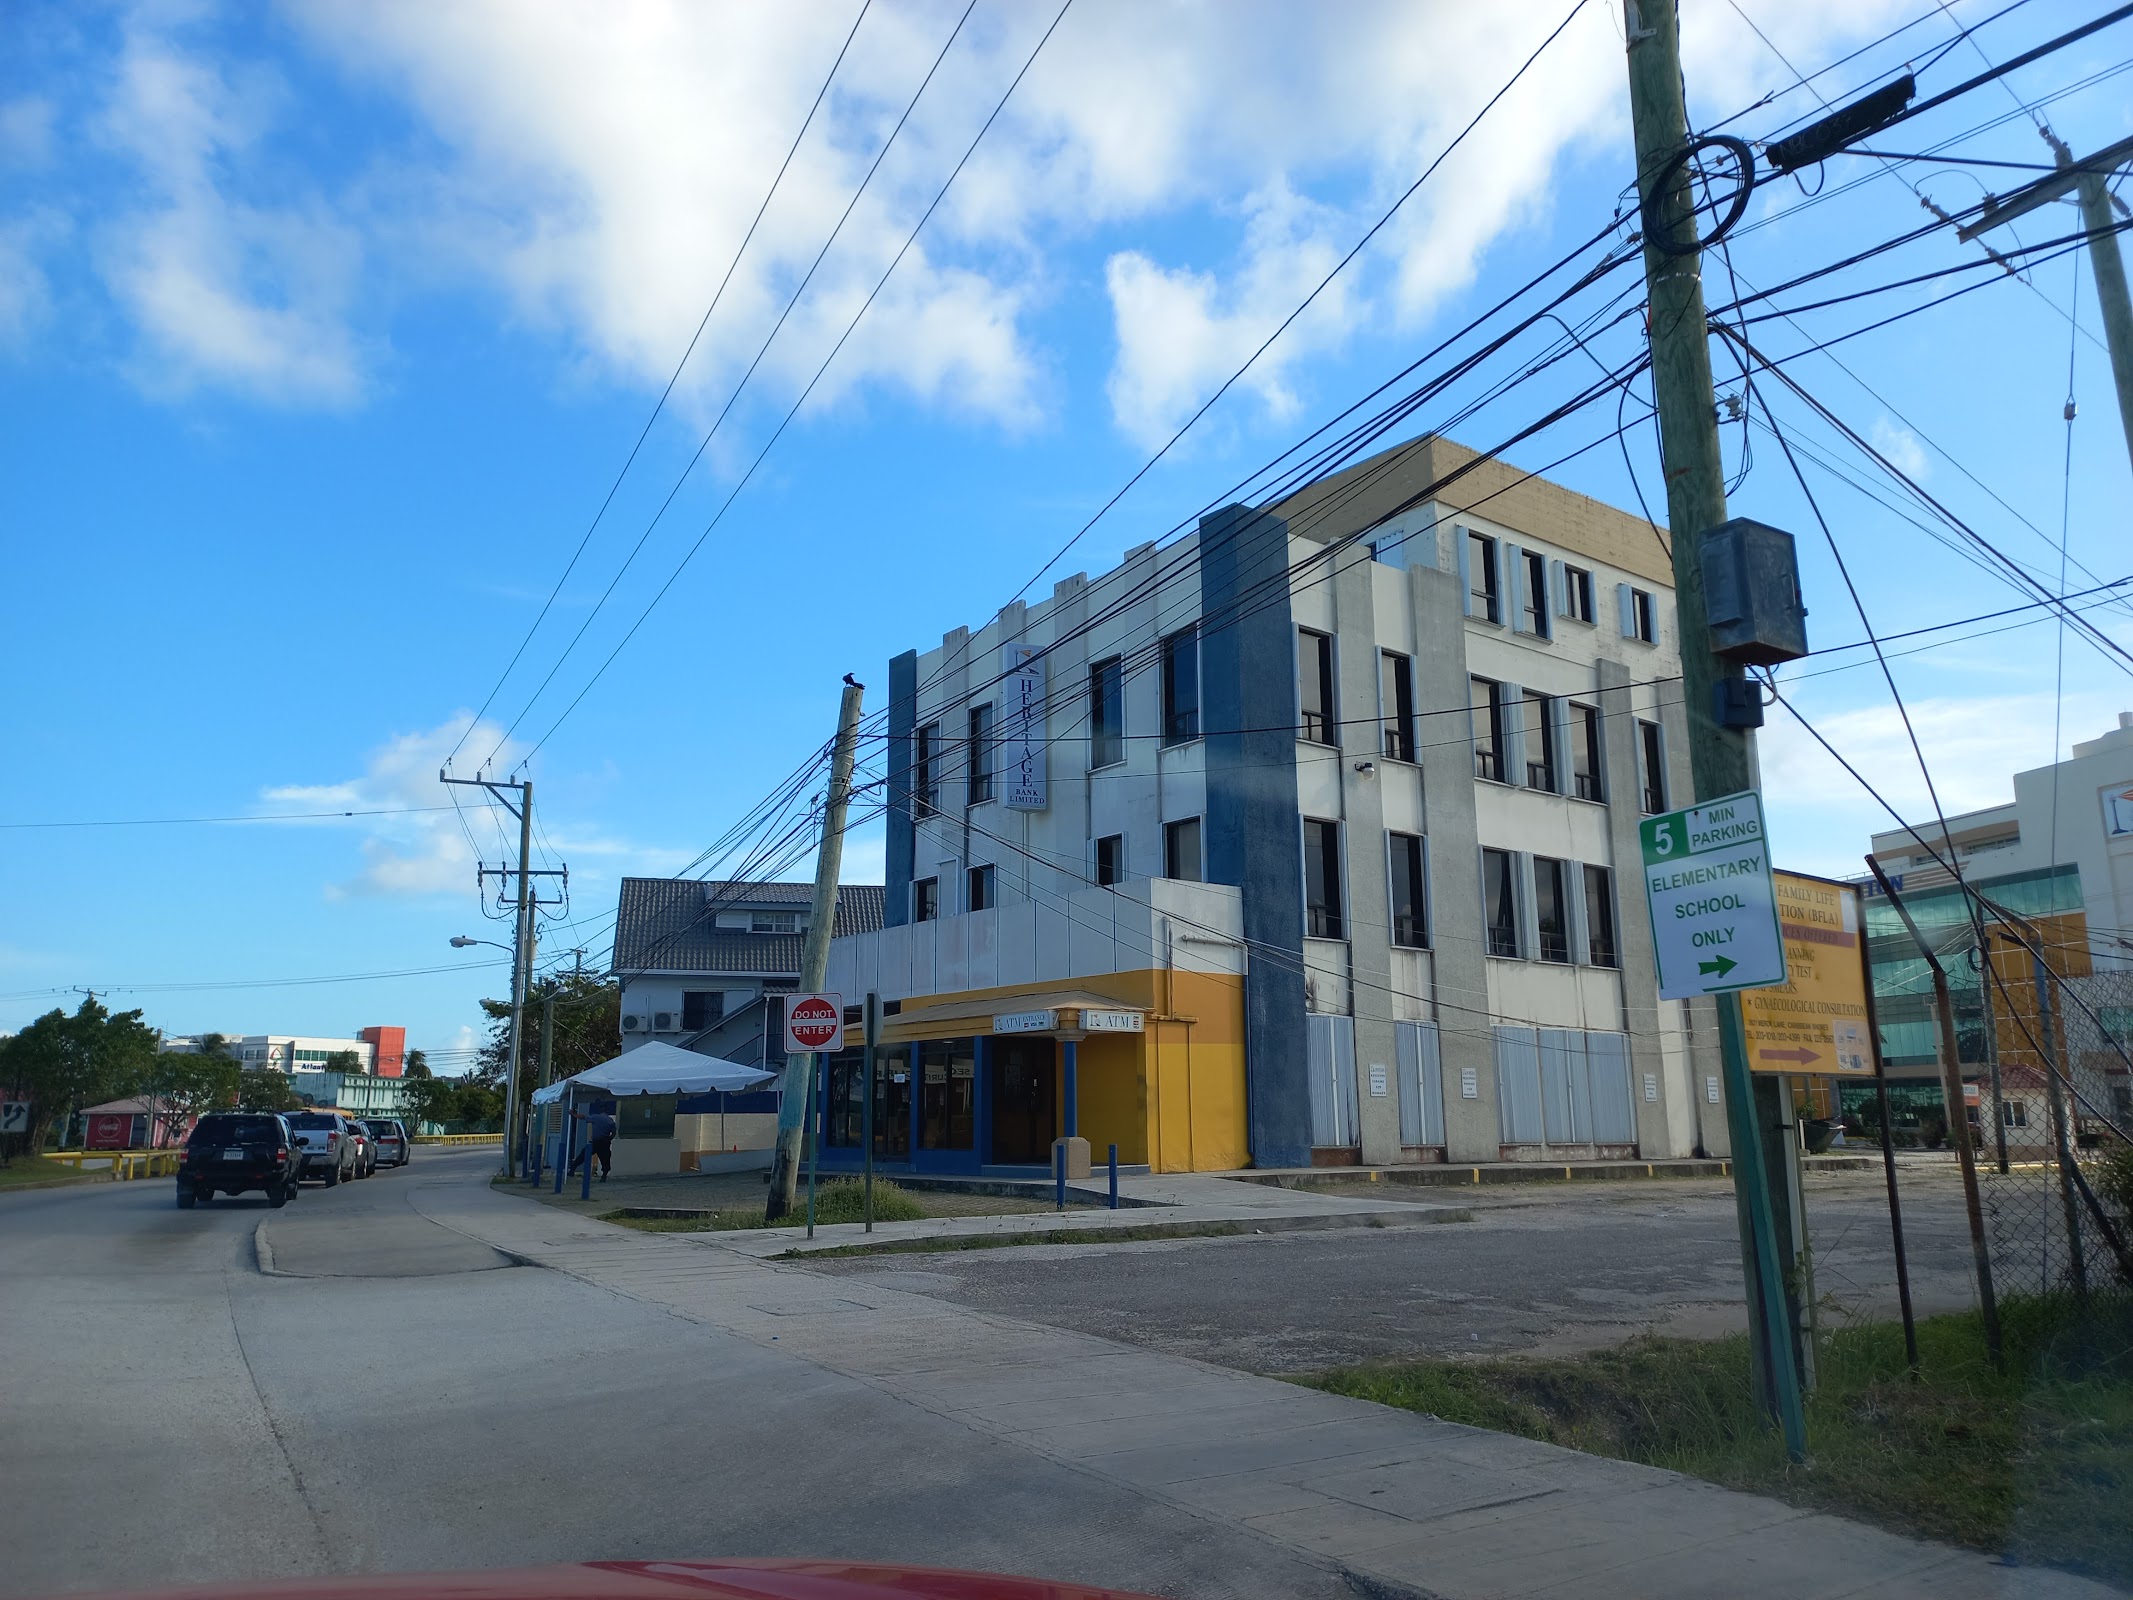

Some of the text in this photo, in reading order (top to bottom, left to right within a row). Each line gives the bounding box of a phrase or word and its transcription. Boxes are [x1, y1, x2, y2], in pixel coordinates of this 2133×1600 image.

[1020, 679, 1033, 787] HERITAGE
[1010, 795, 1045, 804] LIMITED
[1016, 789, 1039, 797] BANK
[1709, 806, 1735, 825] MIN
[1655, 822, 1674, 856] 5
[1692, 820, 1758, 848] PARKING
[1653, 856, 1760, 893] ELEMENTARY
[1778, 884, 1835, 906] FAMILY LIFE
[1675, 893, 1745, 919] SCHOOL
[1808, 909, 1839, 926] (BFLA)
[1692, 927, 1735, 947] ONLY
[1796, 965, 1812, 978] TEST
[795, 1010, 832, 1019] DO NOT
[1754, 997, 1866, 1017] GYNAECOLOGICAL CONSULTATION
[795, 1026, 832, 1035] ENTER
[1005, 1016, 1022, 1028] ATM
[1105, 1015, 1129, 1028] ATM
